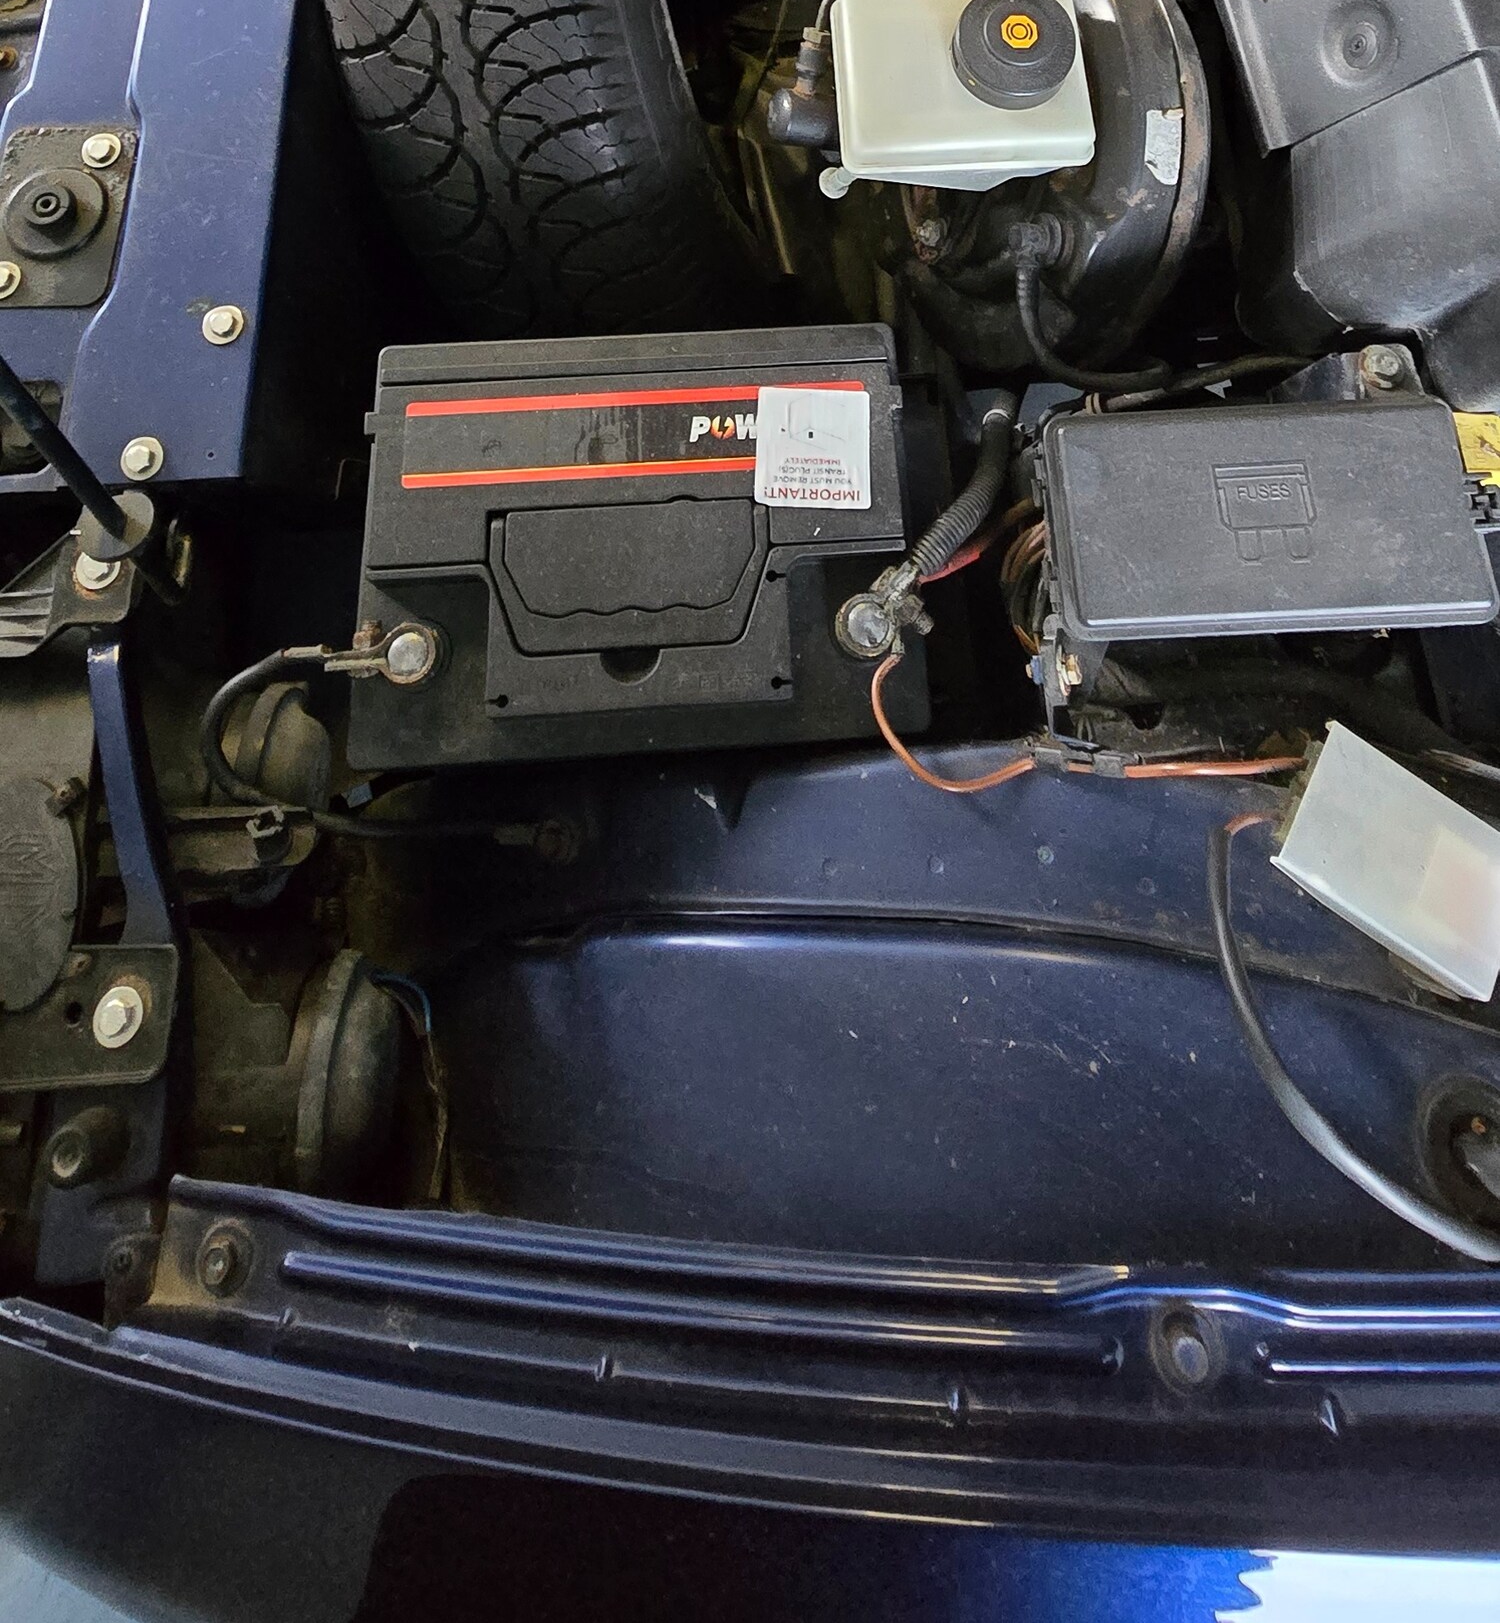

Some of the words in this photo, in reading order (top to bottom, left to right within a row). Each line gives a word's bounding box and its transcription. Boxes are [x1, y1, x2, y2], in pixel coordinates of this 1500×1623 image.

[784, 457, 841, 466] IMMEDIATELY
[814, 467, 846, 475] TRANSIT
[773, 475, 808, 484] REMOVE
[810, 477, 832, 485] MUST
[835, 477, 852, 485] YOU
[764, 485, 860, 501] IMPORTANT!
[1237, 482, 1292, 502] FUSES
